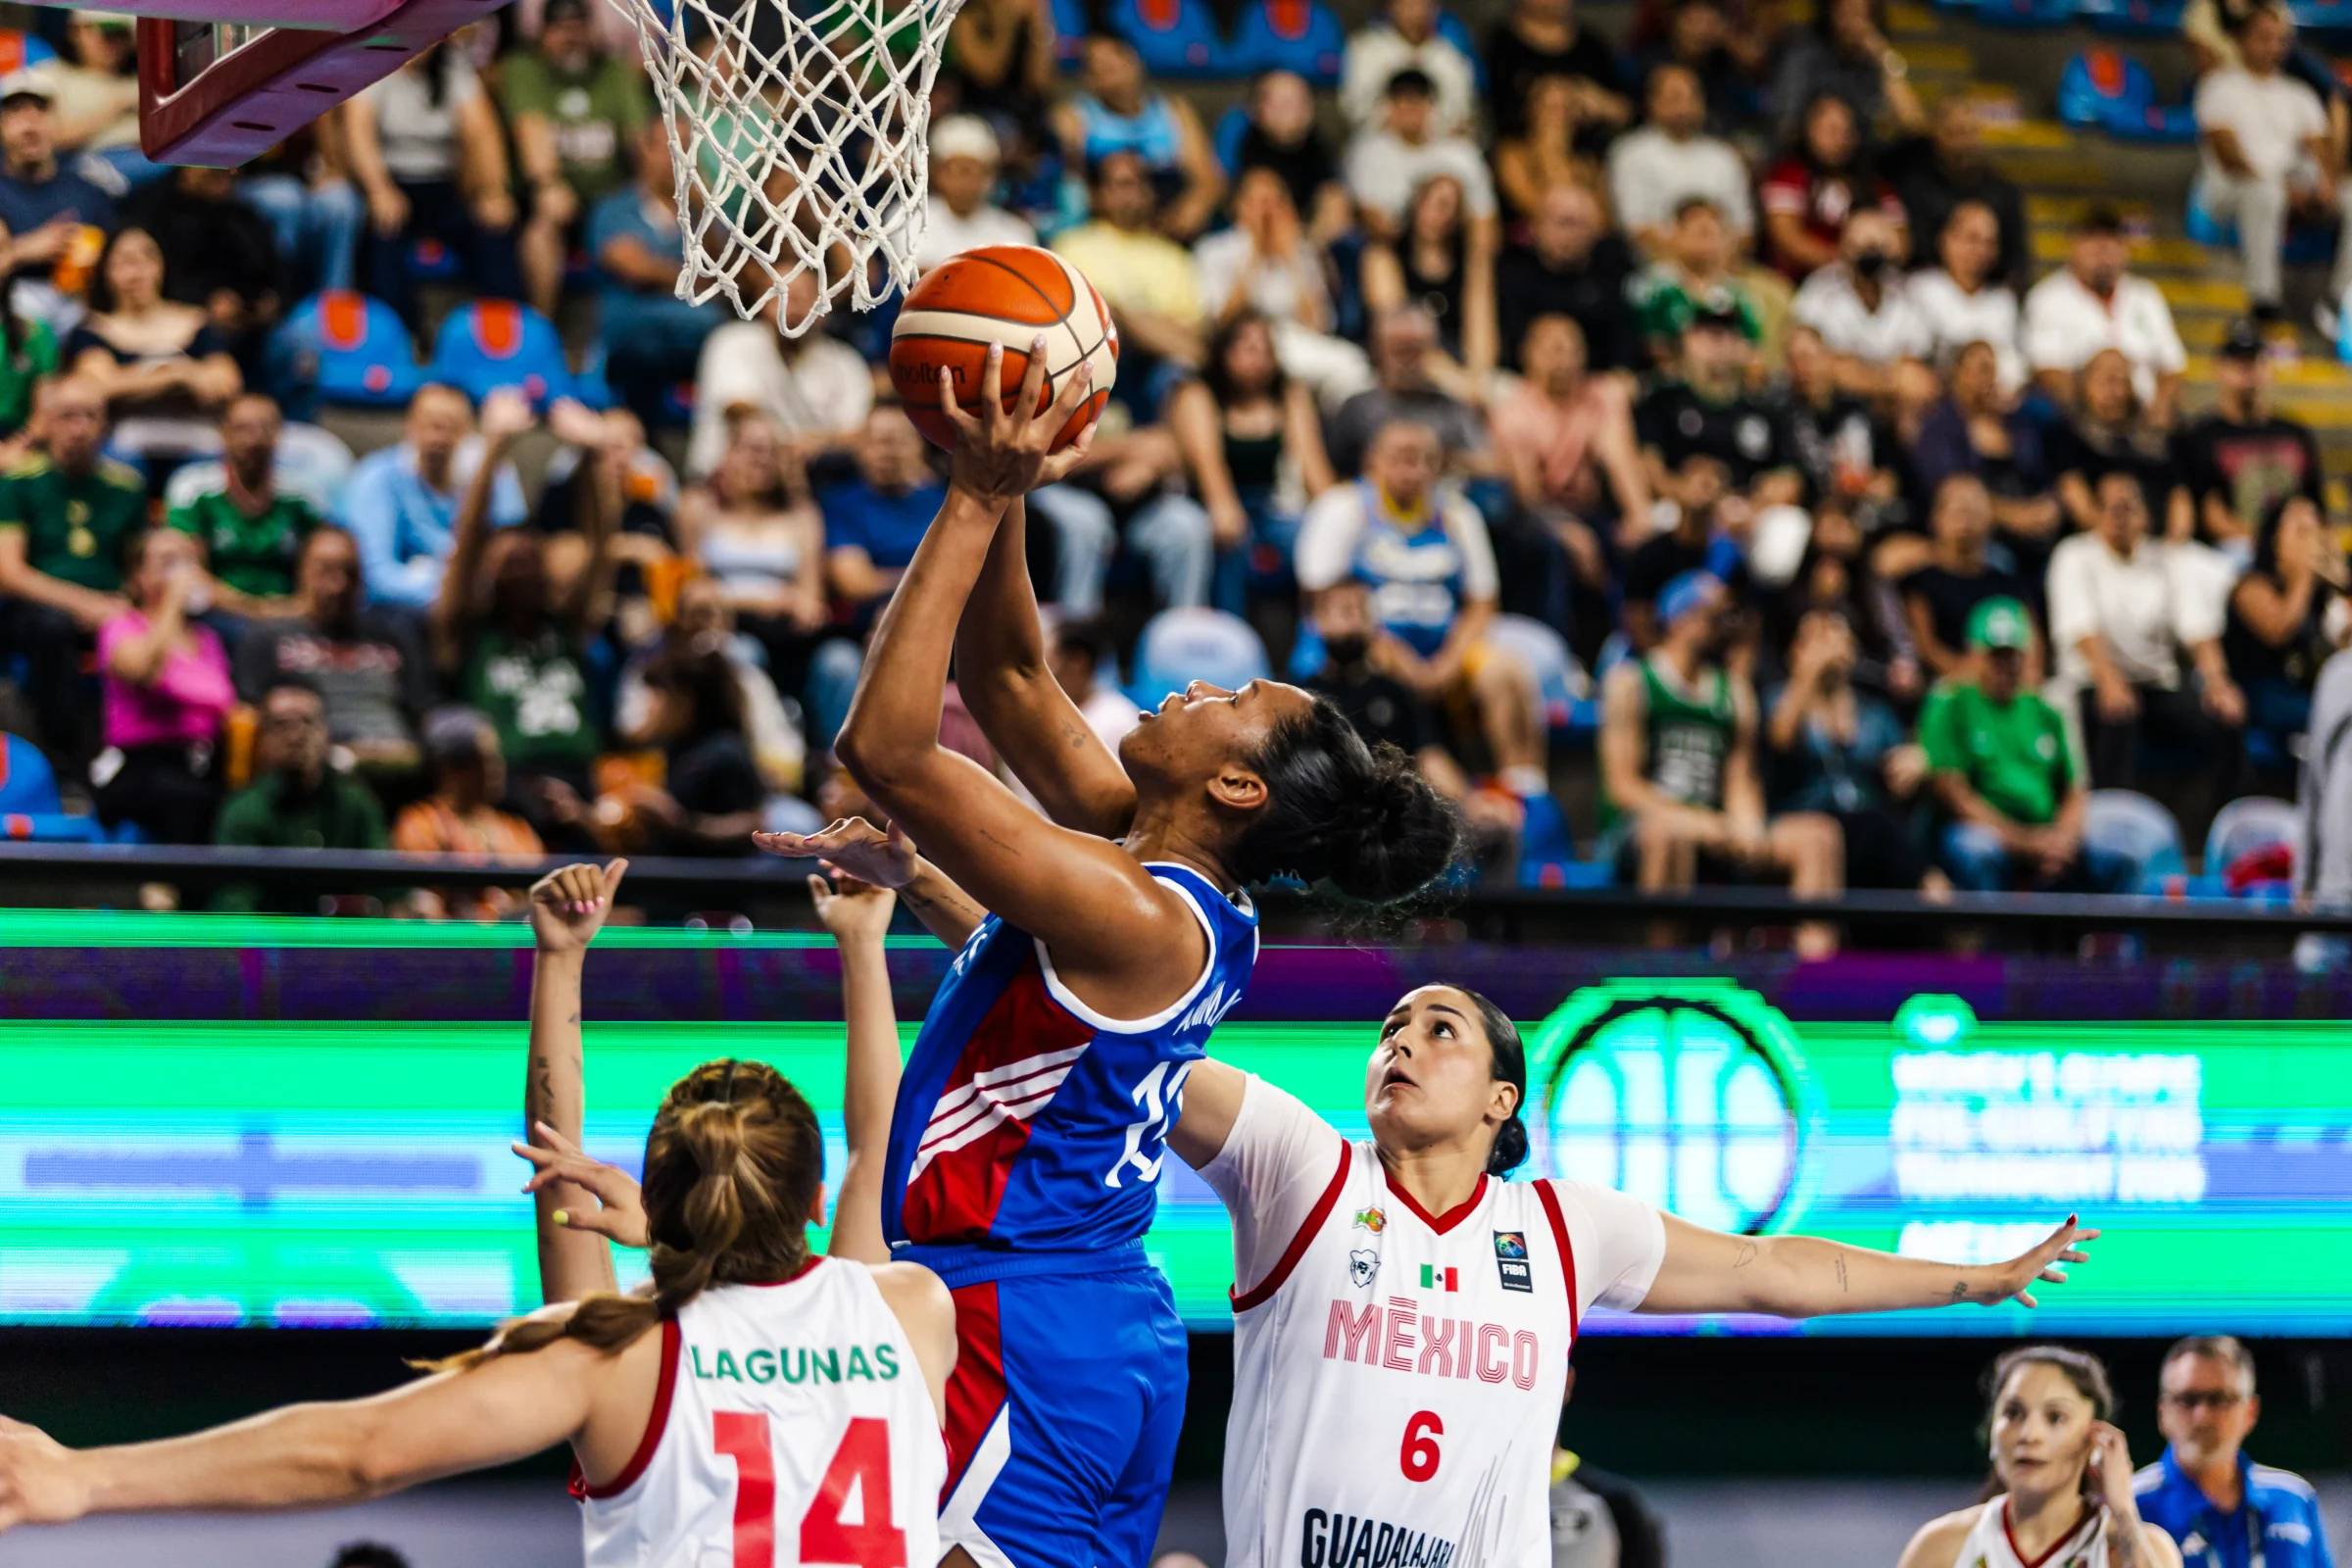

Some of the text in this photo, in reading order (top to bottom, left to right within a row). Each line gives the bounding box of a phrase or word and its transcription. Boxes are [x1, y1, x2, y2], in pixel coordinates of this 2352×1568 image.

[1501, 1263, 1527, 1277] FIBA
[691, 1344, 900, 1386] LAGUNAS
[1323, 1296, 1539, 1391] MÉXICO
[1399, 1410, 1444, 1483] 6
[712, 1410, 908, 1568] 14
